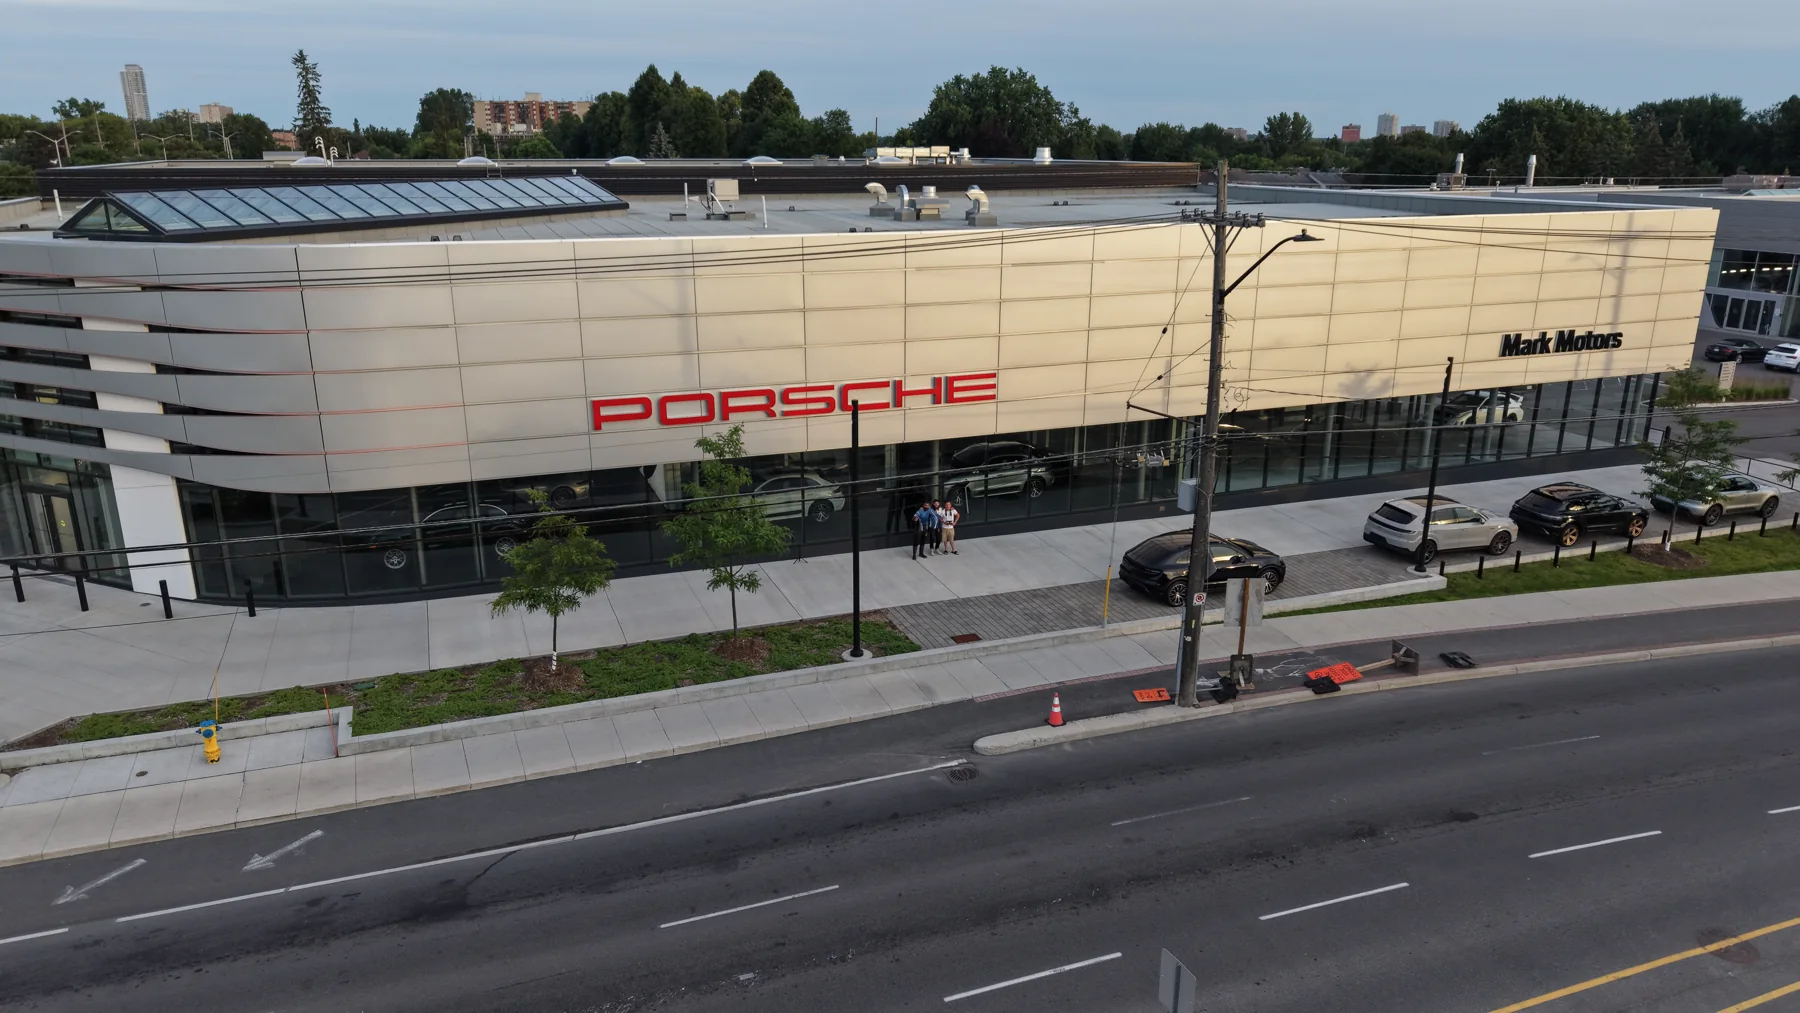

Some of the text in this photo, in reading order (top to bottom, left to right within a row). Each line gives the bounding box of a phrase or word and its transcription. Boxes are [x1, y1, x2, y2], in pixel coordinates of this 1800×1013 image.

[1500, 329, 1623, 357] Mark Motors
[592, 372, 997, 431] PORSCHE
